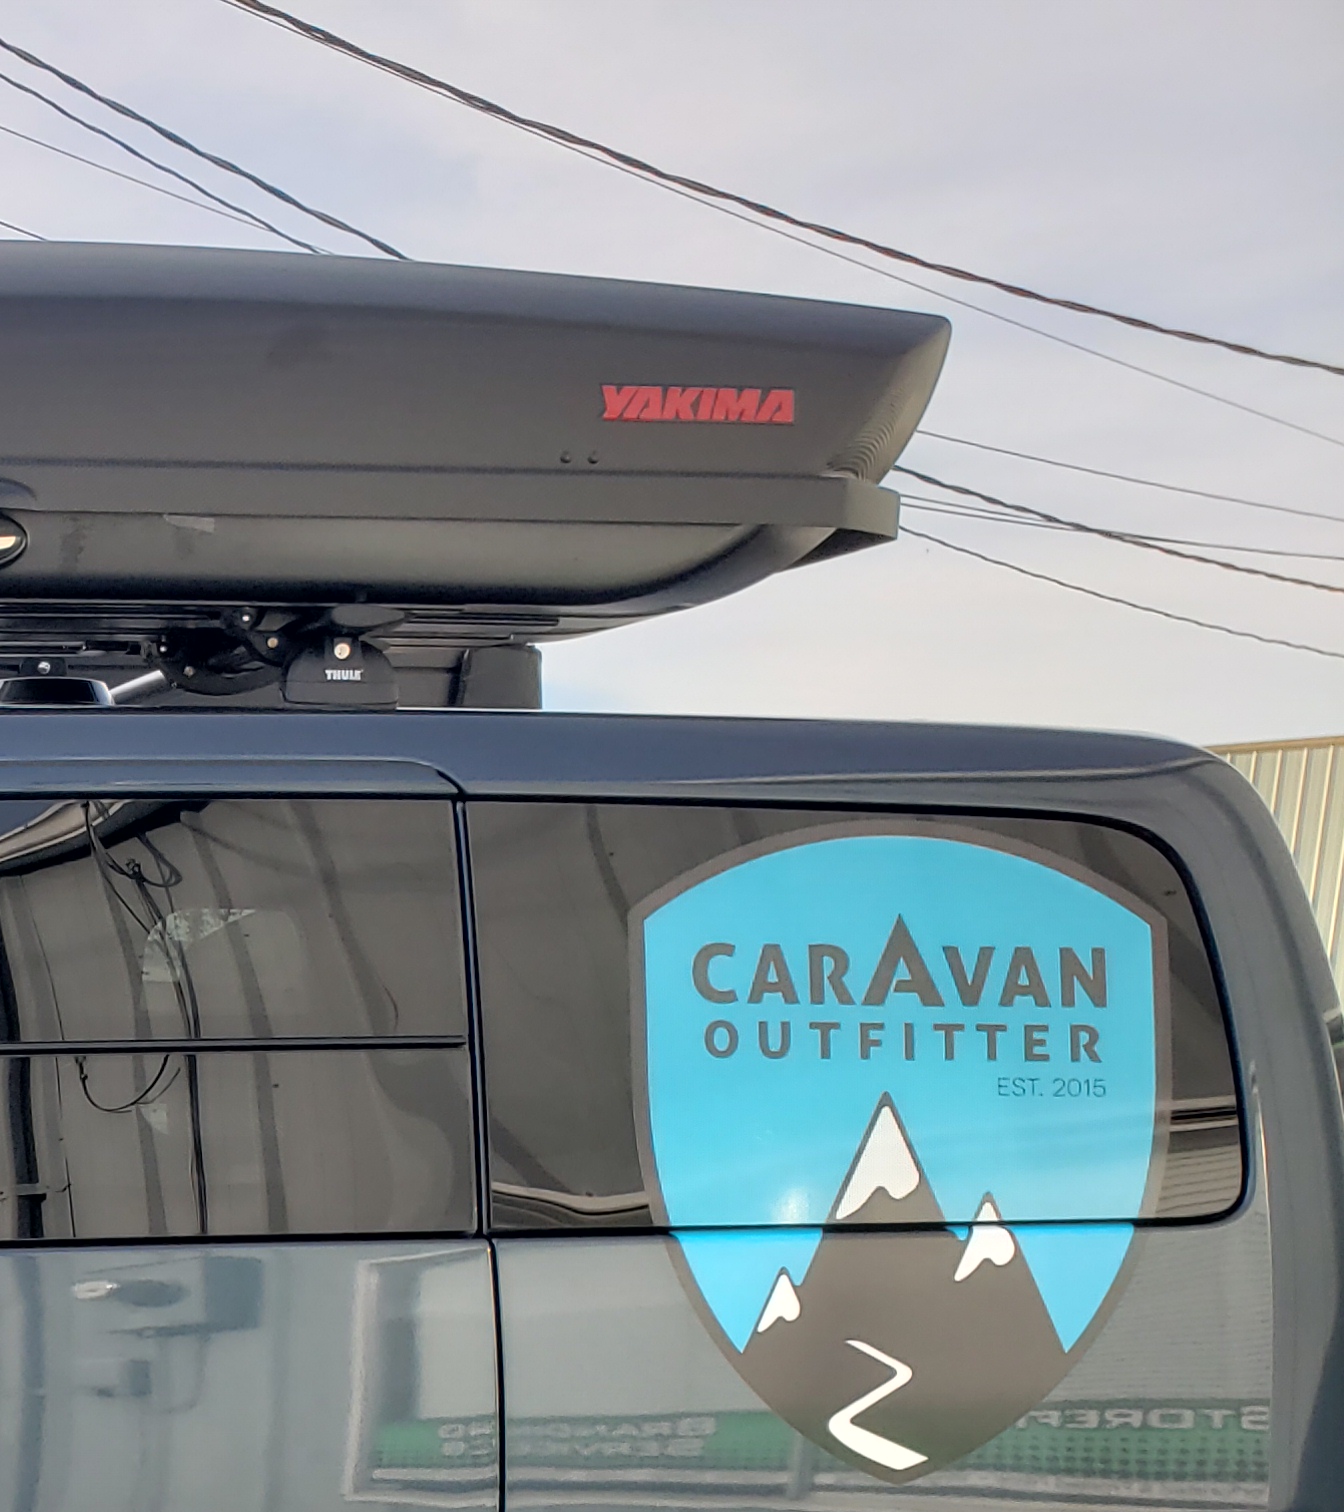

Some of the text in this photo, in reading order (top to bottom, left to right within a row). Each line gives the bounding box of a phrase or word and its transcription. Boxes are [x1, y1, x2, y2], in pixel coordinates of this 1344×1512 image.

[601, 384, 795, 424] YAKIMA
[325, 669, 362, 682] THULE
[692, 913, 1108, 1008] CARAVAN
[704, 1019, 1103, 1063] OUTFITTER
[998, 1077, 1107, 1098] EST. 2015
